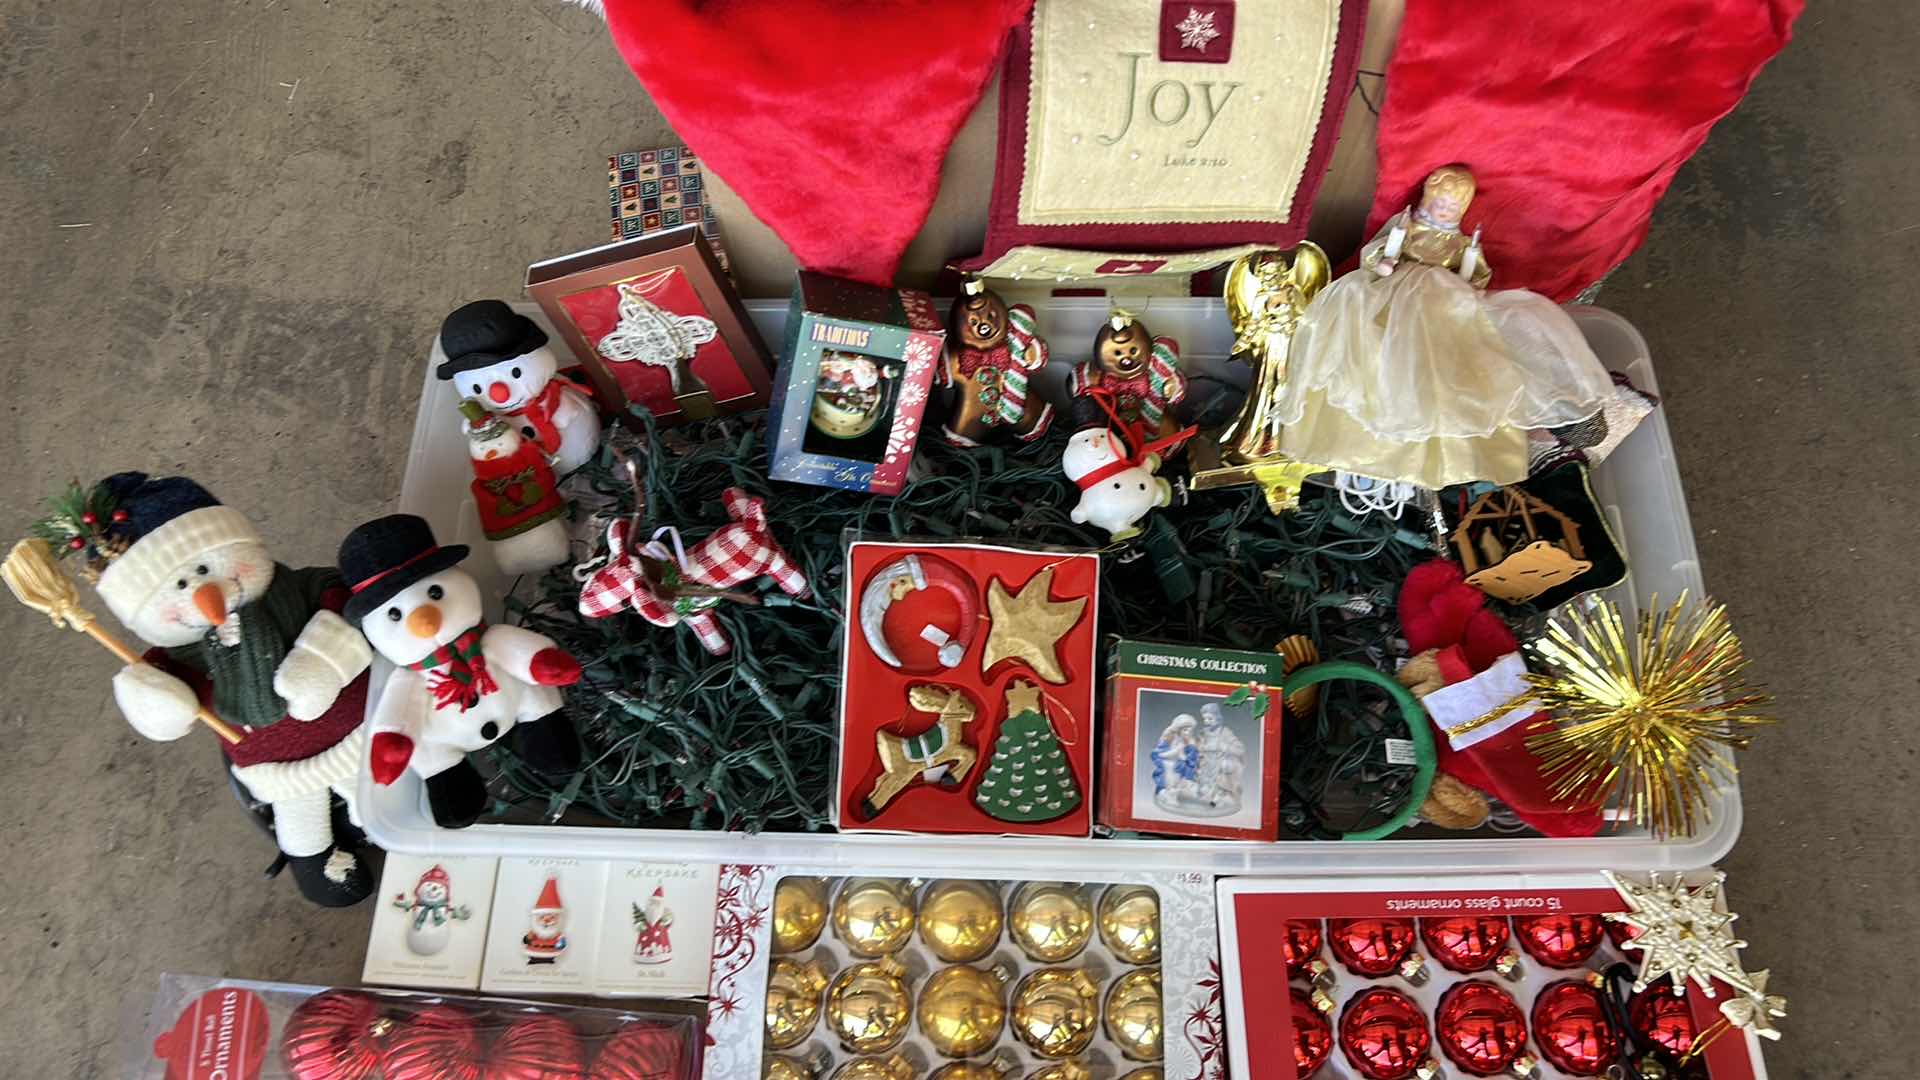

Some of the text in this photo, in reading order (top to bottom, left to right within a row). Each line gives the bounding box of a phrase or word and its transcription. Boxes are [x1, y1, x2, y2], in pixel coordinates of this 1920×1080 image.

[1096, 52, 1243, 148] Joy
[1163, 154, 1197, 167] Luke
[812, 323, 870, 348] TRADITIONS
[1136, 653, 1268, 675] CHRISTMAS COLLECTION
[1386, 895, 1563, 912] 15 count glass ornaments
[208, 991, 239, 1080] Ornaments
